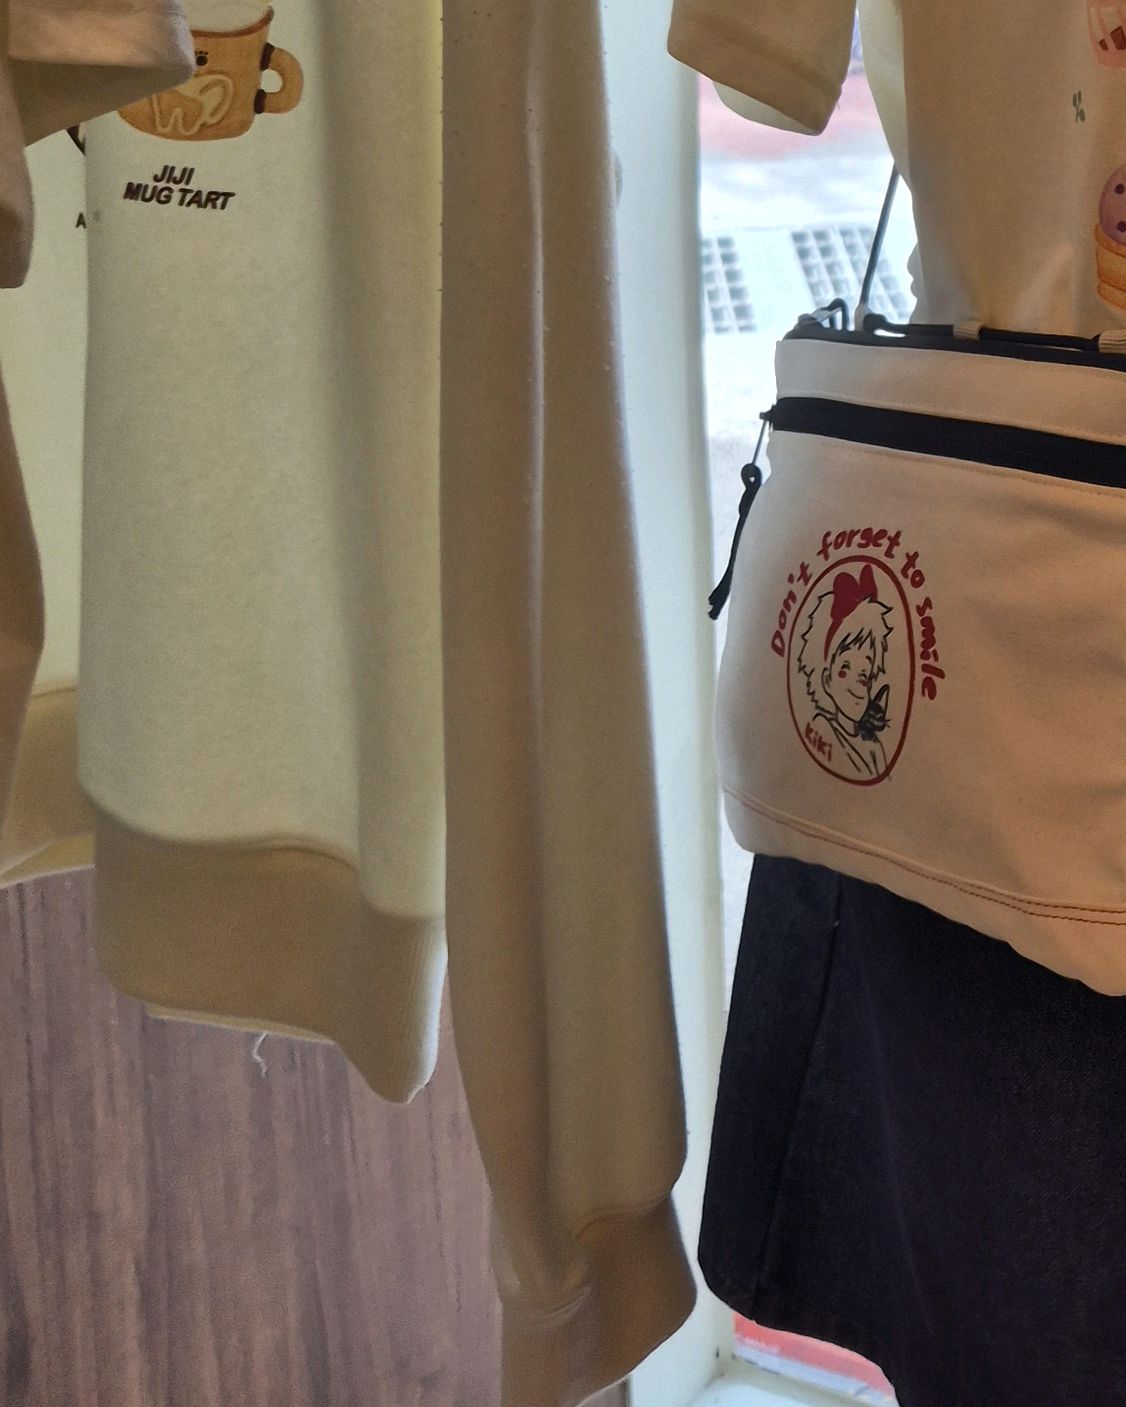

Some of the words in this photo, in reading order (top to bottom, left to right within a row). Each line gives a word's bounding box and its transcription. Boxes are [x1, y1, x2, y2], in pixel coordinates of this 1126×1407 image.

[153, 165, 195, 185] JIJI
[123, 182, 174, 204] MUG
[178, 188, 236, 210] TART
[771, 561, 813, 657] Don't
[816, 527, 901, 561] forget
[901, 551, 925, 588] to
[916, 597, 945, 700] smile
